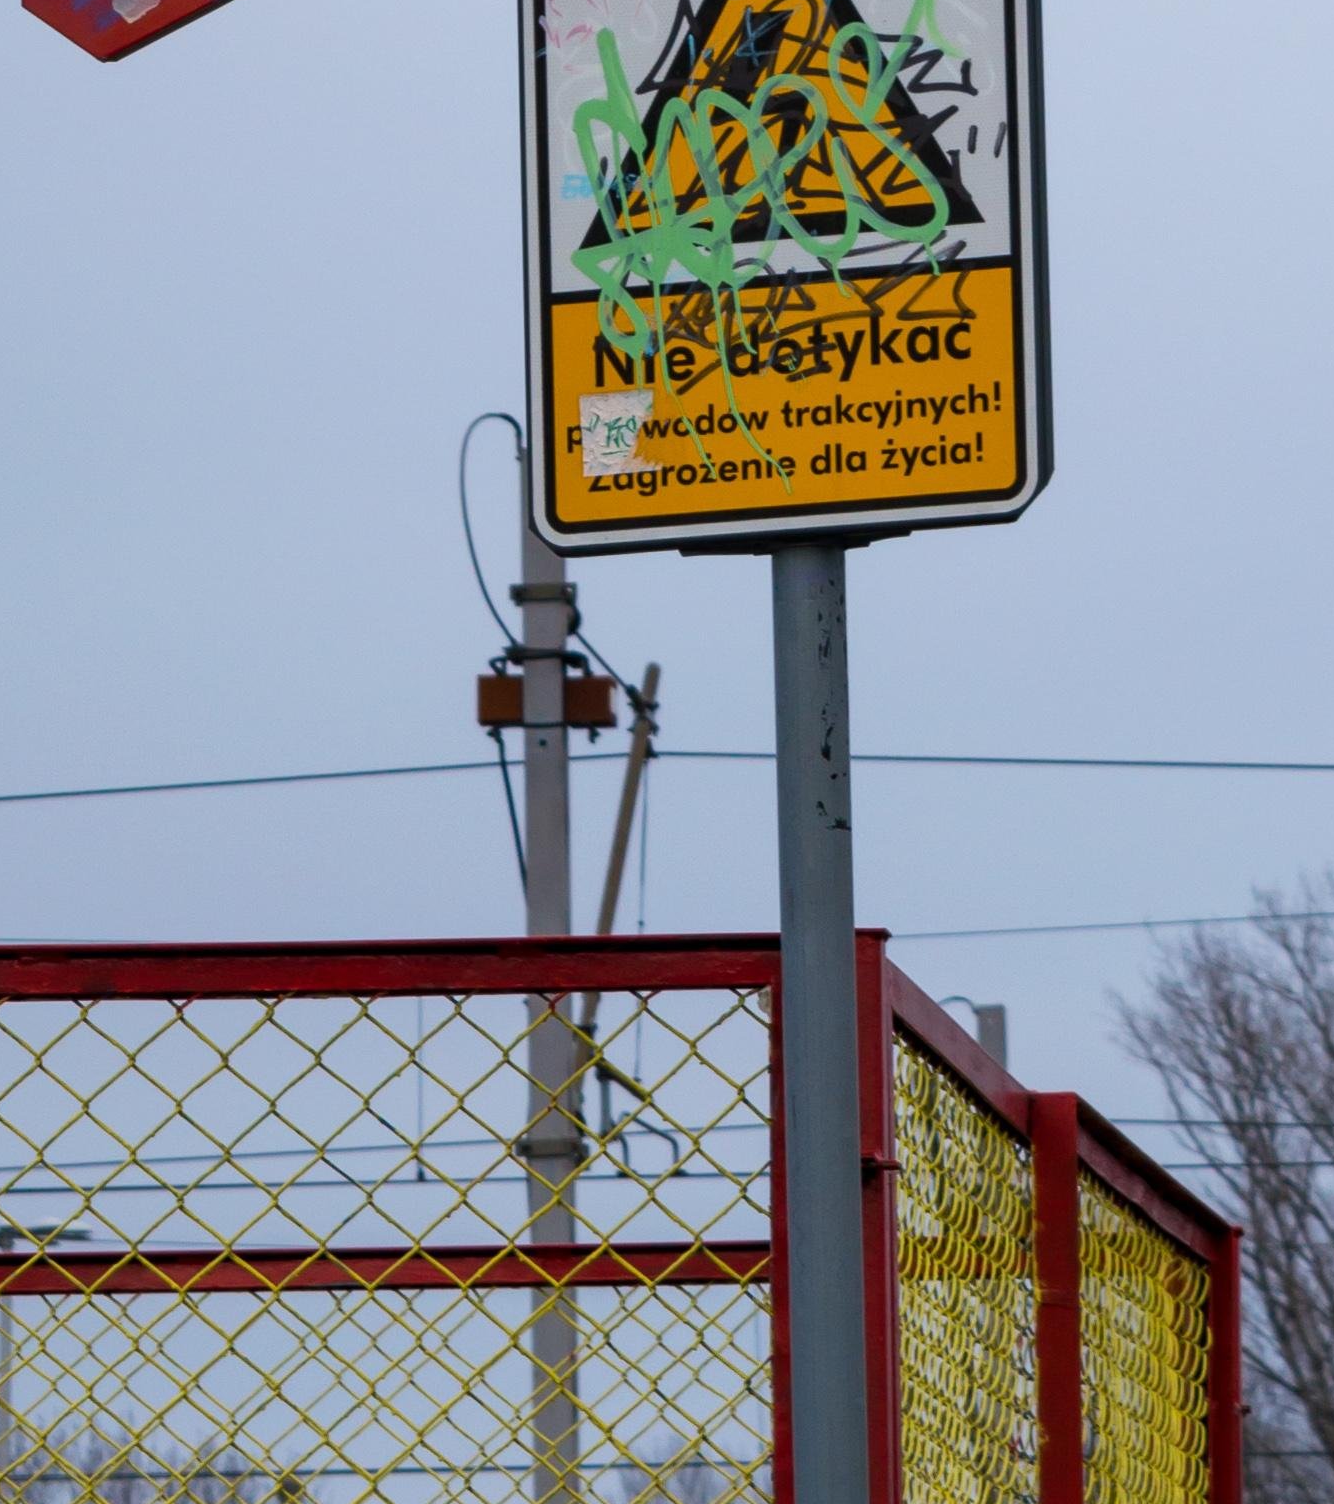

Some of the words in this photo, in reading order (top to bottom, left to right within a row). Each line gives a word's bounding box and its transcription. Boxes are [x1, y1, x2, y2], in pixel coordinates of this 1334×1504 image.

[593, 332, 697, 387] Nie
[565, 407, 771, 454] pwodów
[779, 380, 1003, 430] trakcyjnych!
[809, 442, 869, 478] dla
[879, 430, 987, 478] życia!
